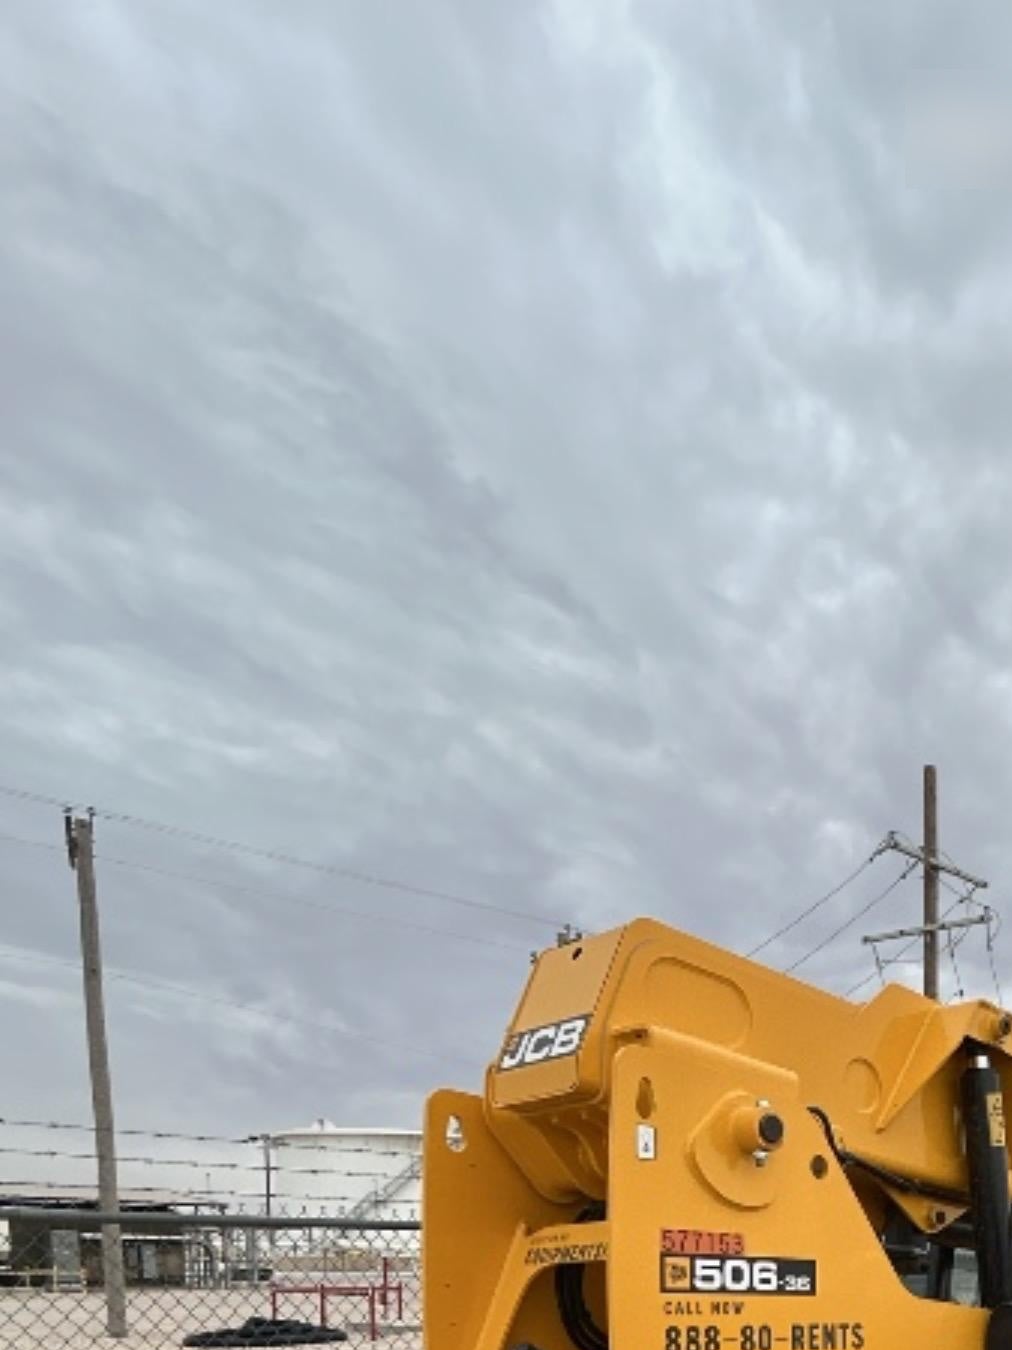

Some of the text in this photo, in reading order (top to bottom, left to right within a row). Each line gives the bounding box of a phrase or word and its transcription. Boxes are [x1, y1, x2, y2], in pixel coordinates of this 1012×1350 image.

[500, 1018, 587, 1069] JCB
[661, 1229, 744, 1256] 577153
[663, 1301, 703, 1316] CALL
